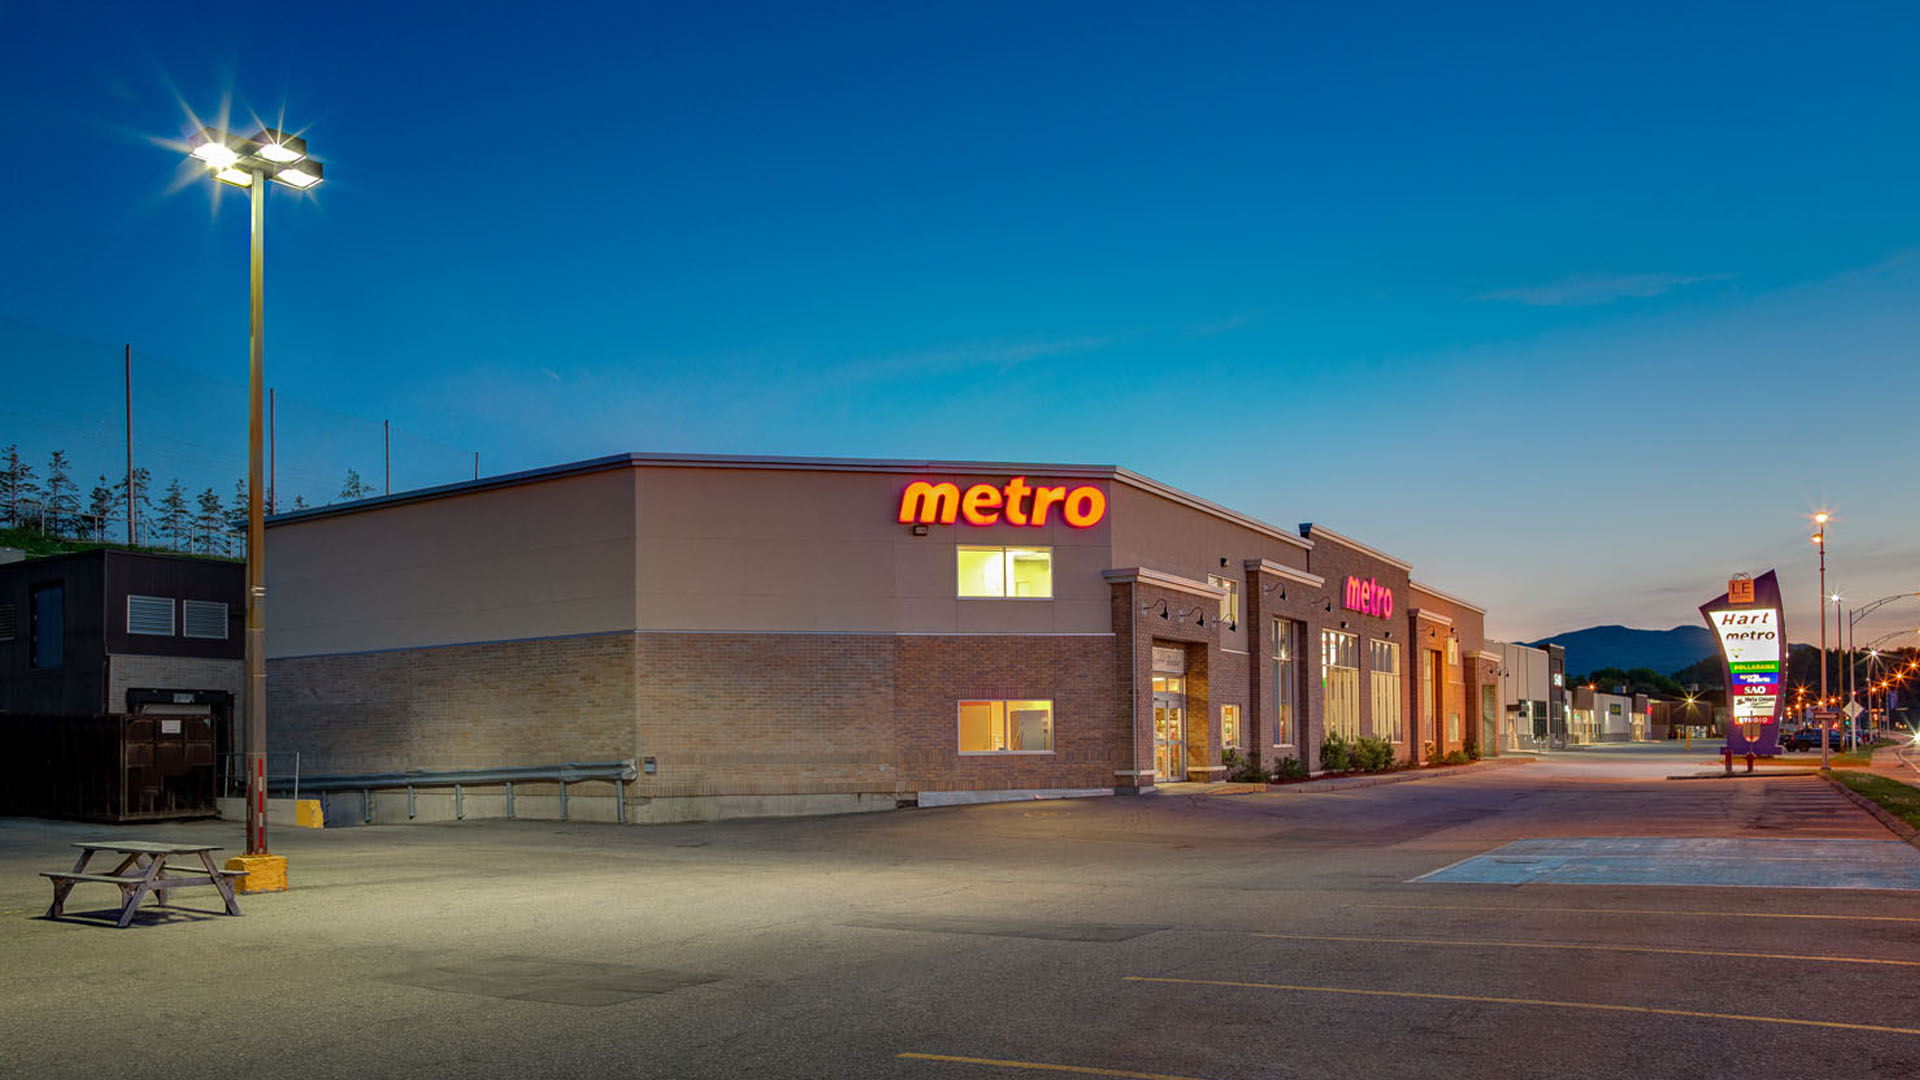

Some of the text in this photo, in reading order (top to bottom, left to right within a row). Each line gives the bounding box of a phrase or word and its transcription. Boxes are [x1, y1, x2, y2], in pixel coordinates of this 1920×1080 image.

[899, 476, 1106, 528] metro
[1731, 582, 1751, 595] LE
[1345, 575, 1393, 620] metro
[1722, 612, 1769, 625] Hart
[1726, 630, 1775, 640] metro
